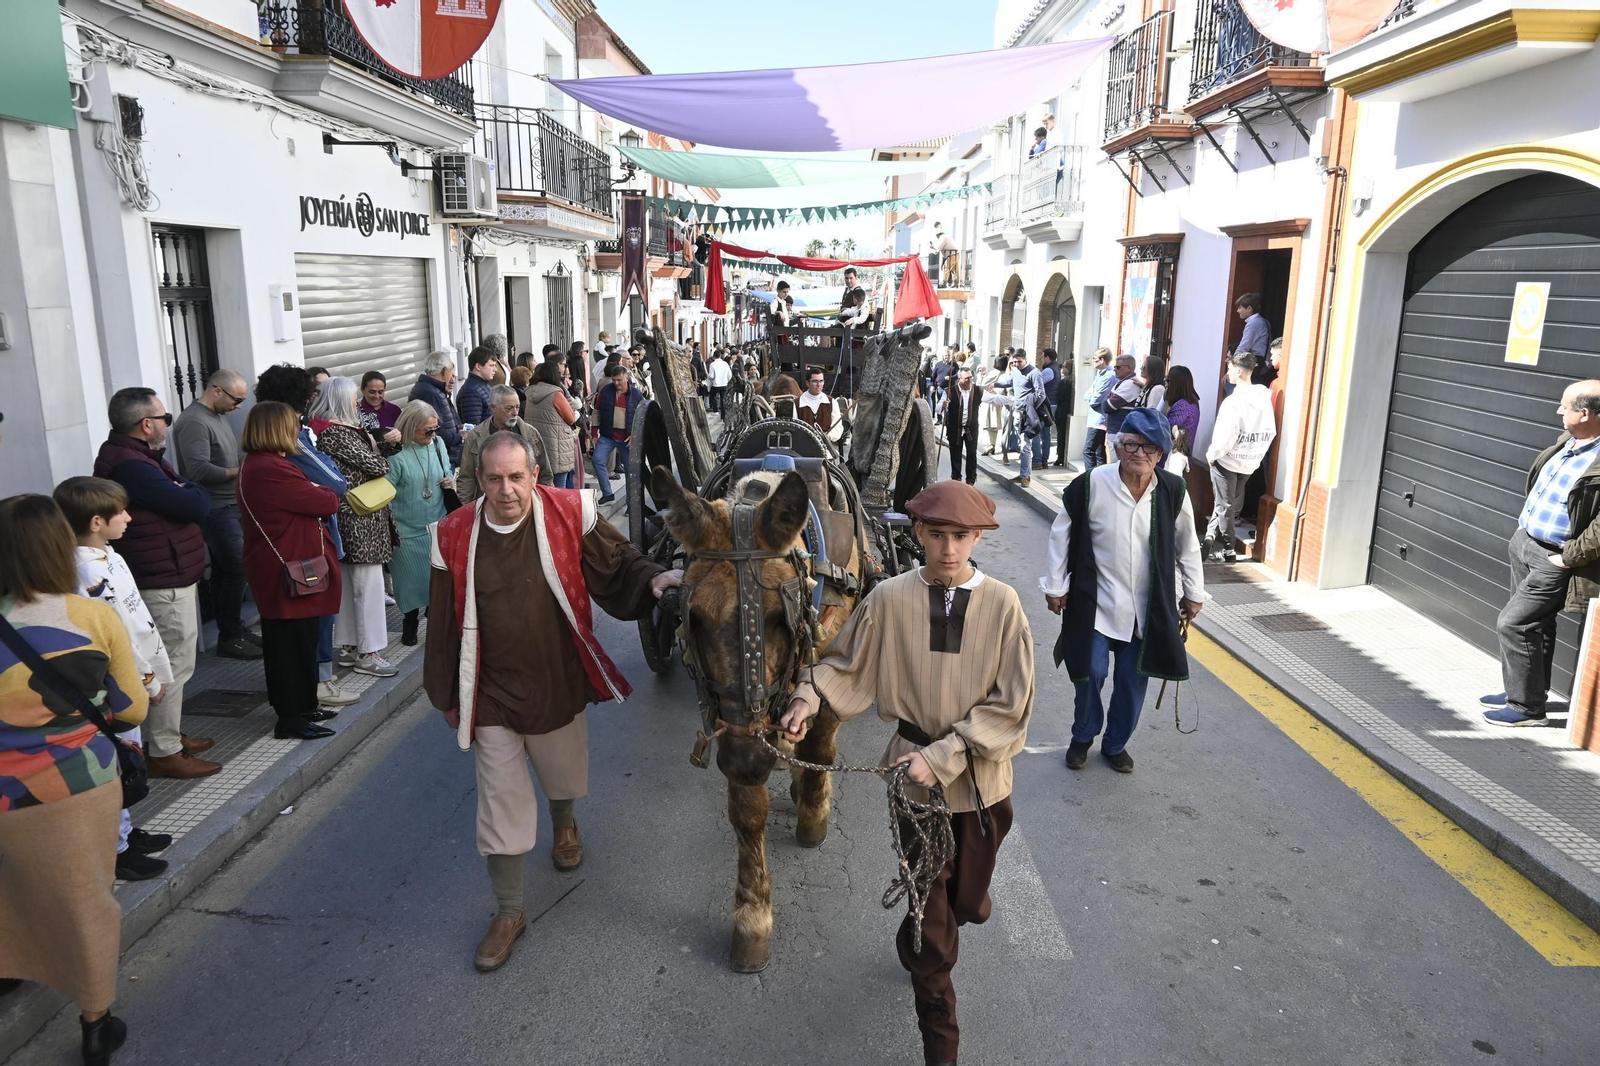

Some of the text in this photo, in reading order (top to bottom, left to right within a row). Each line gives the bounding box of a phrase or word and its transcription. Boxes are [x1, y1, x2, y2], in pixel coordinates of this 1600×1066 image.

[299, 194, 431, 240] JOYERÍA SAN JORGE
